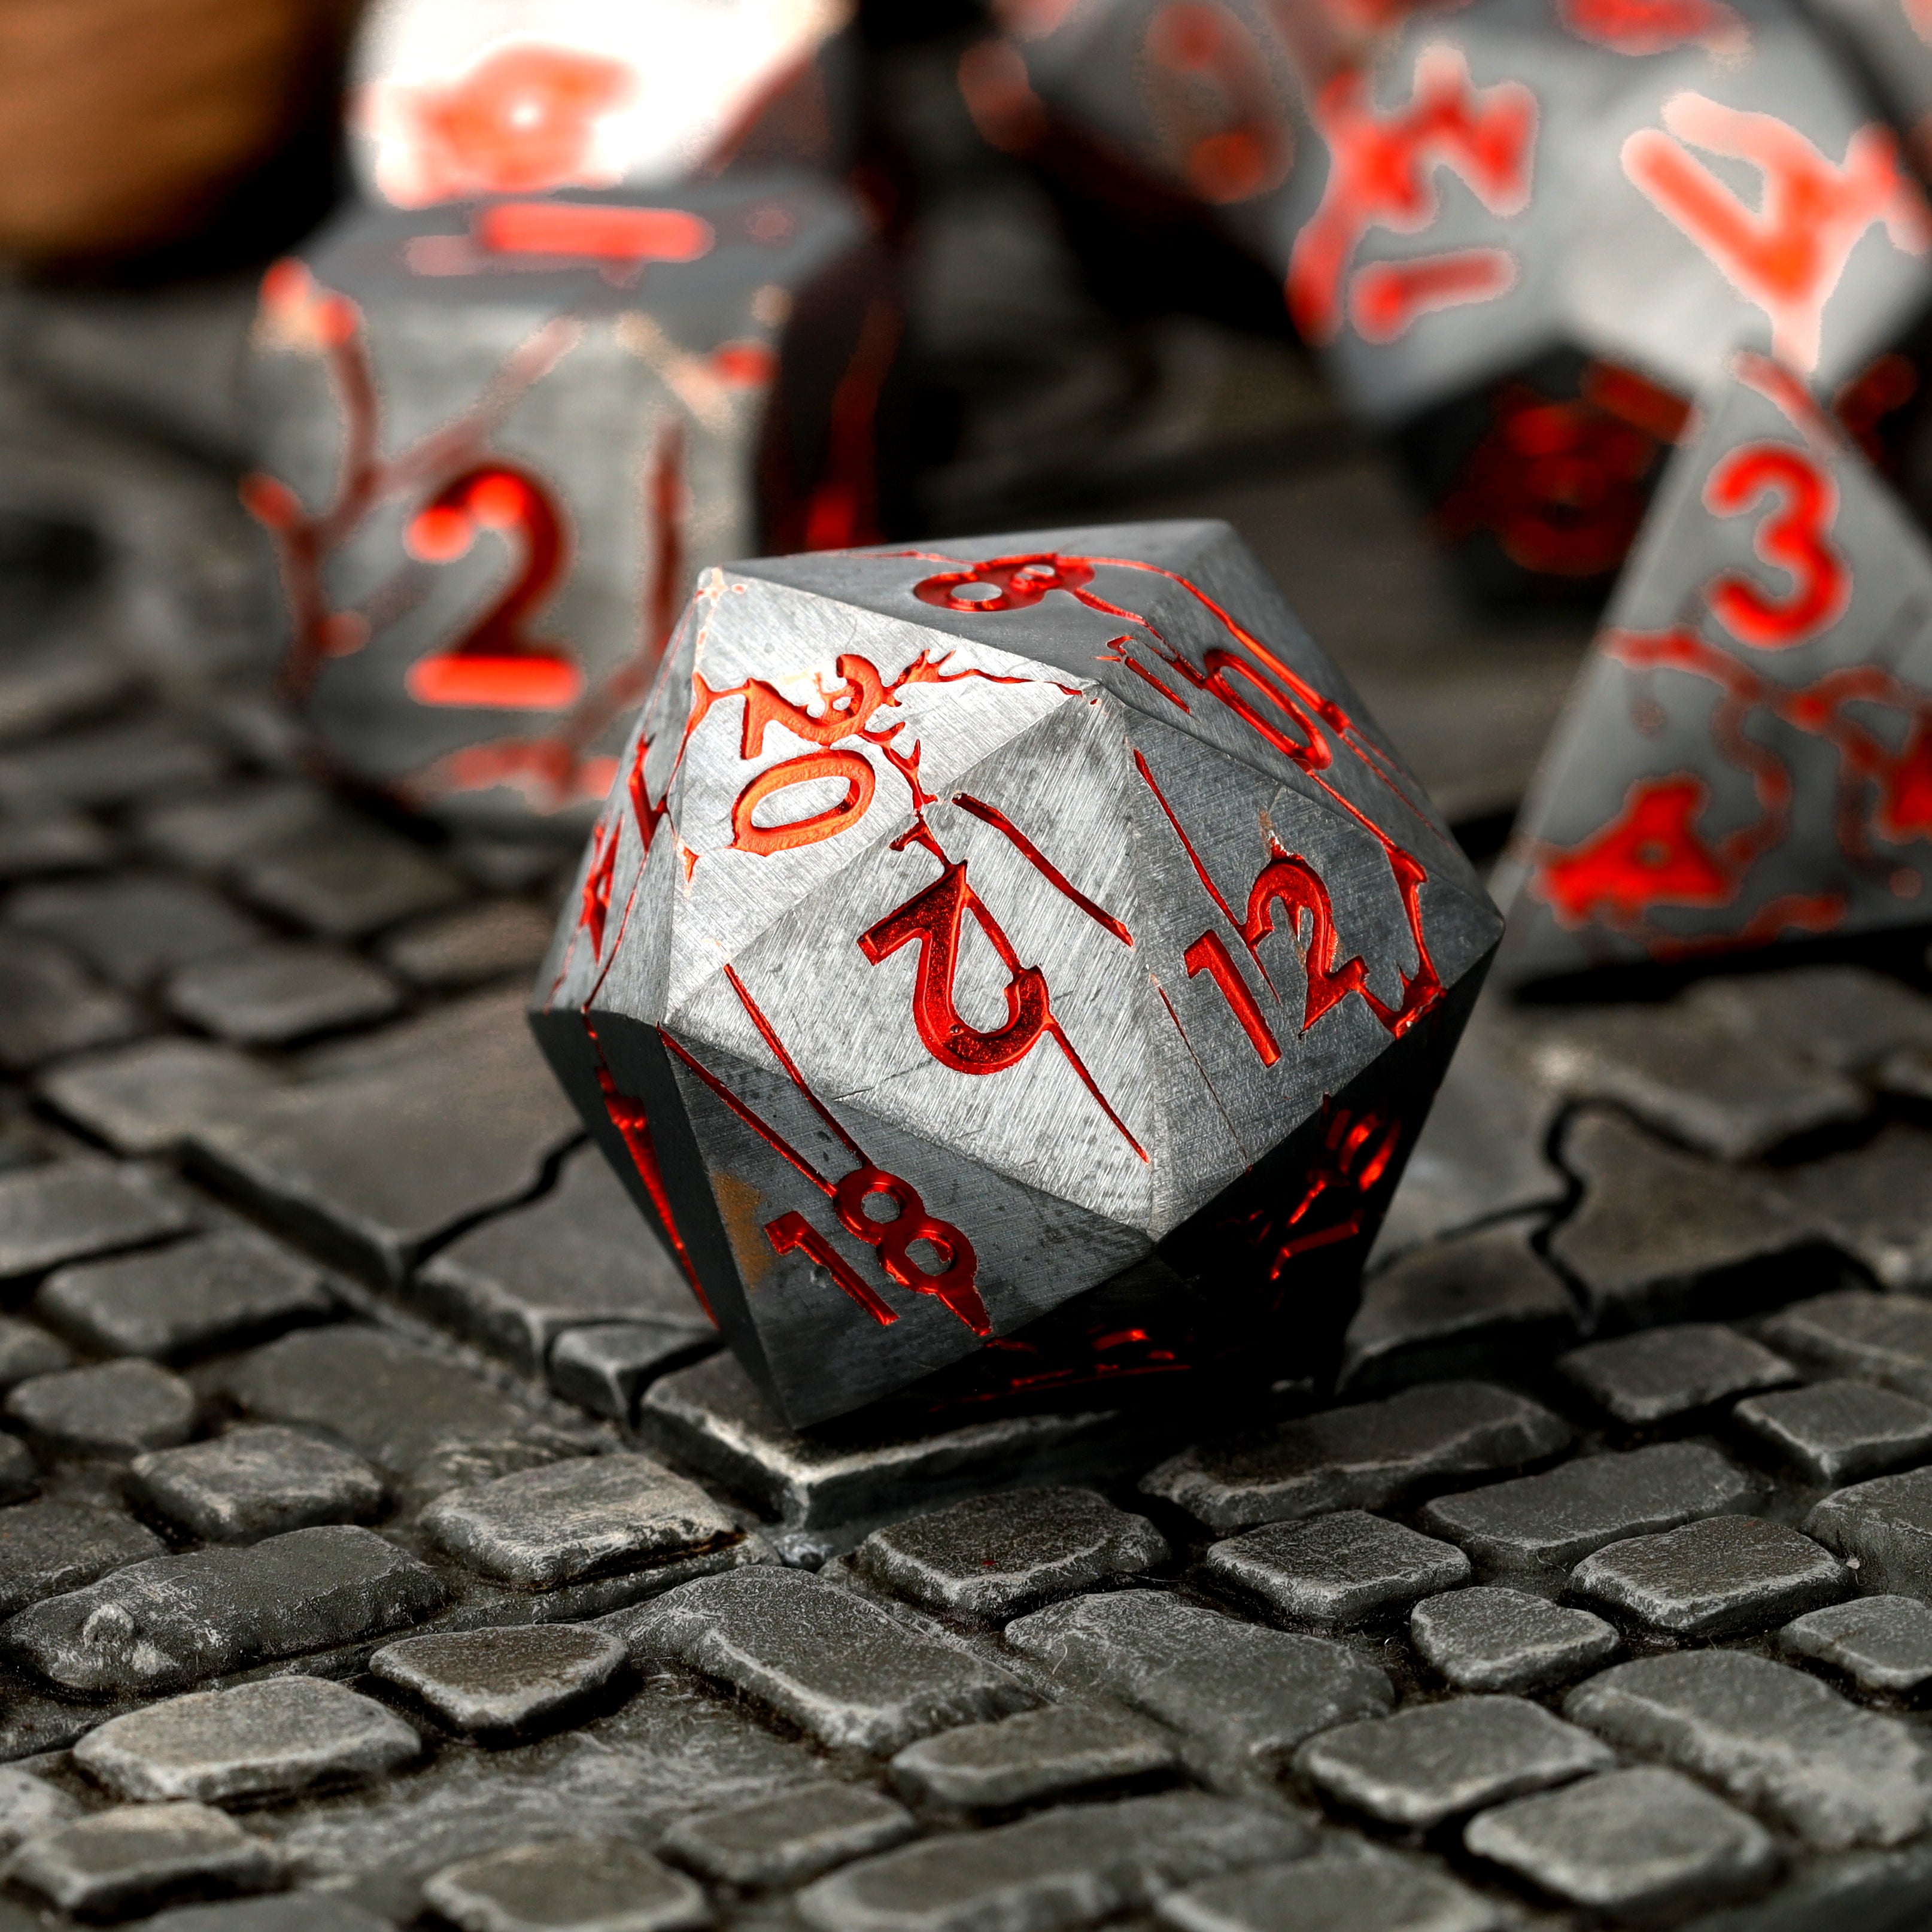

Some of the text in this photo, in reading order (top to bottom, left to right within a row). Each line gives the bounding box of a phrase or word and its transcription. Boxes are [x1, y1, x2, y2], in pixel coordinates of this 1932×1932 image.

[407, 464, 582, 706] 2
[913, 552, 1095, 612] 8
[1705, 442, 1851, 649] 3
[731, 653, 885, 856] 20
[1107, 636, 1332, 772] 10
[1535, 776, 1736, 925] 4
[856, 860, 1051, 1076] 2
[1183, 855, 1369, 1067] 12
[765, 1163, 978, 1325] 18
